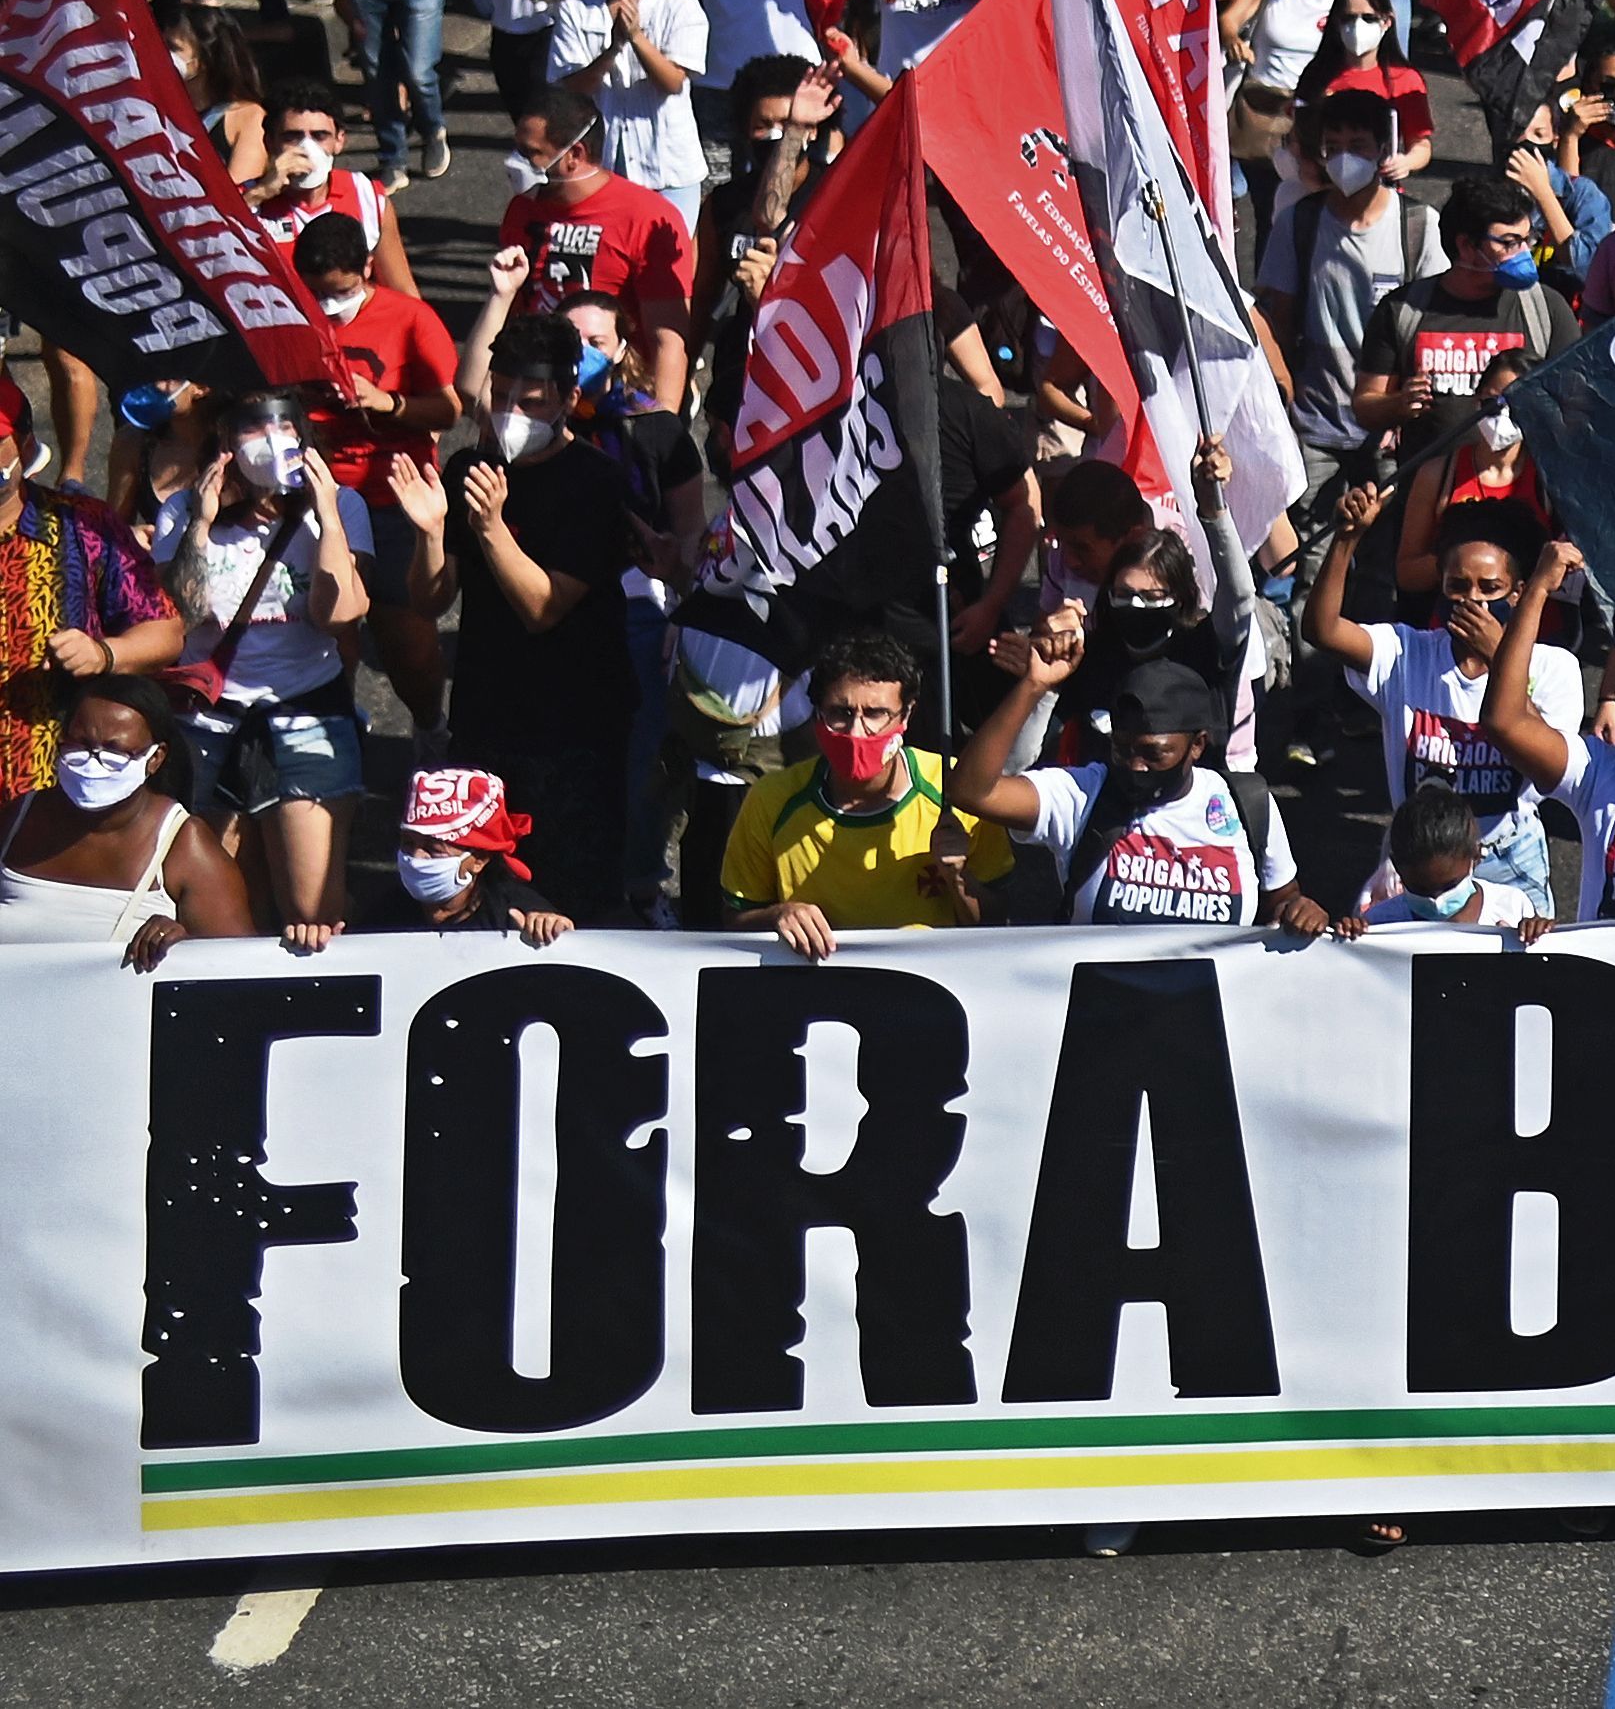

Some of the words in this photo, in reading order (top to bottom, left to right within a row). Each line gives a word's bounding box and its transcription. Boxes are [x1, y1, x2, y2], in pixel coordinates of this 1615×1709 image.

[1006, 189, 1053, 252] FAVELAS
[1067, 255, 1111, 318] ESTADO
[1422, 348, 1498, 375] BRIGAD
[1415, 734, 1511, 769] BRIGADA
[1415, 763, 1512, 795] PLARES
[407, 800, 467, 824] BRASIL
[1116, 853, 1231, 894] BRIGADAS
[1108, 882, 1232, 923] POPULARES
[140, 960, 1282, 1448] FORA
